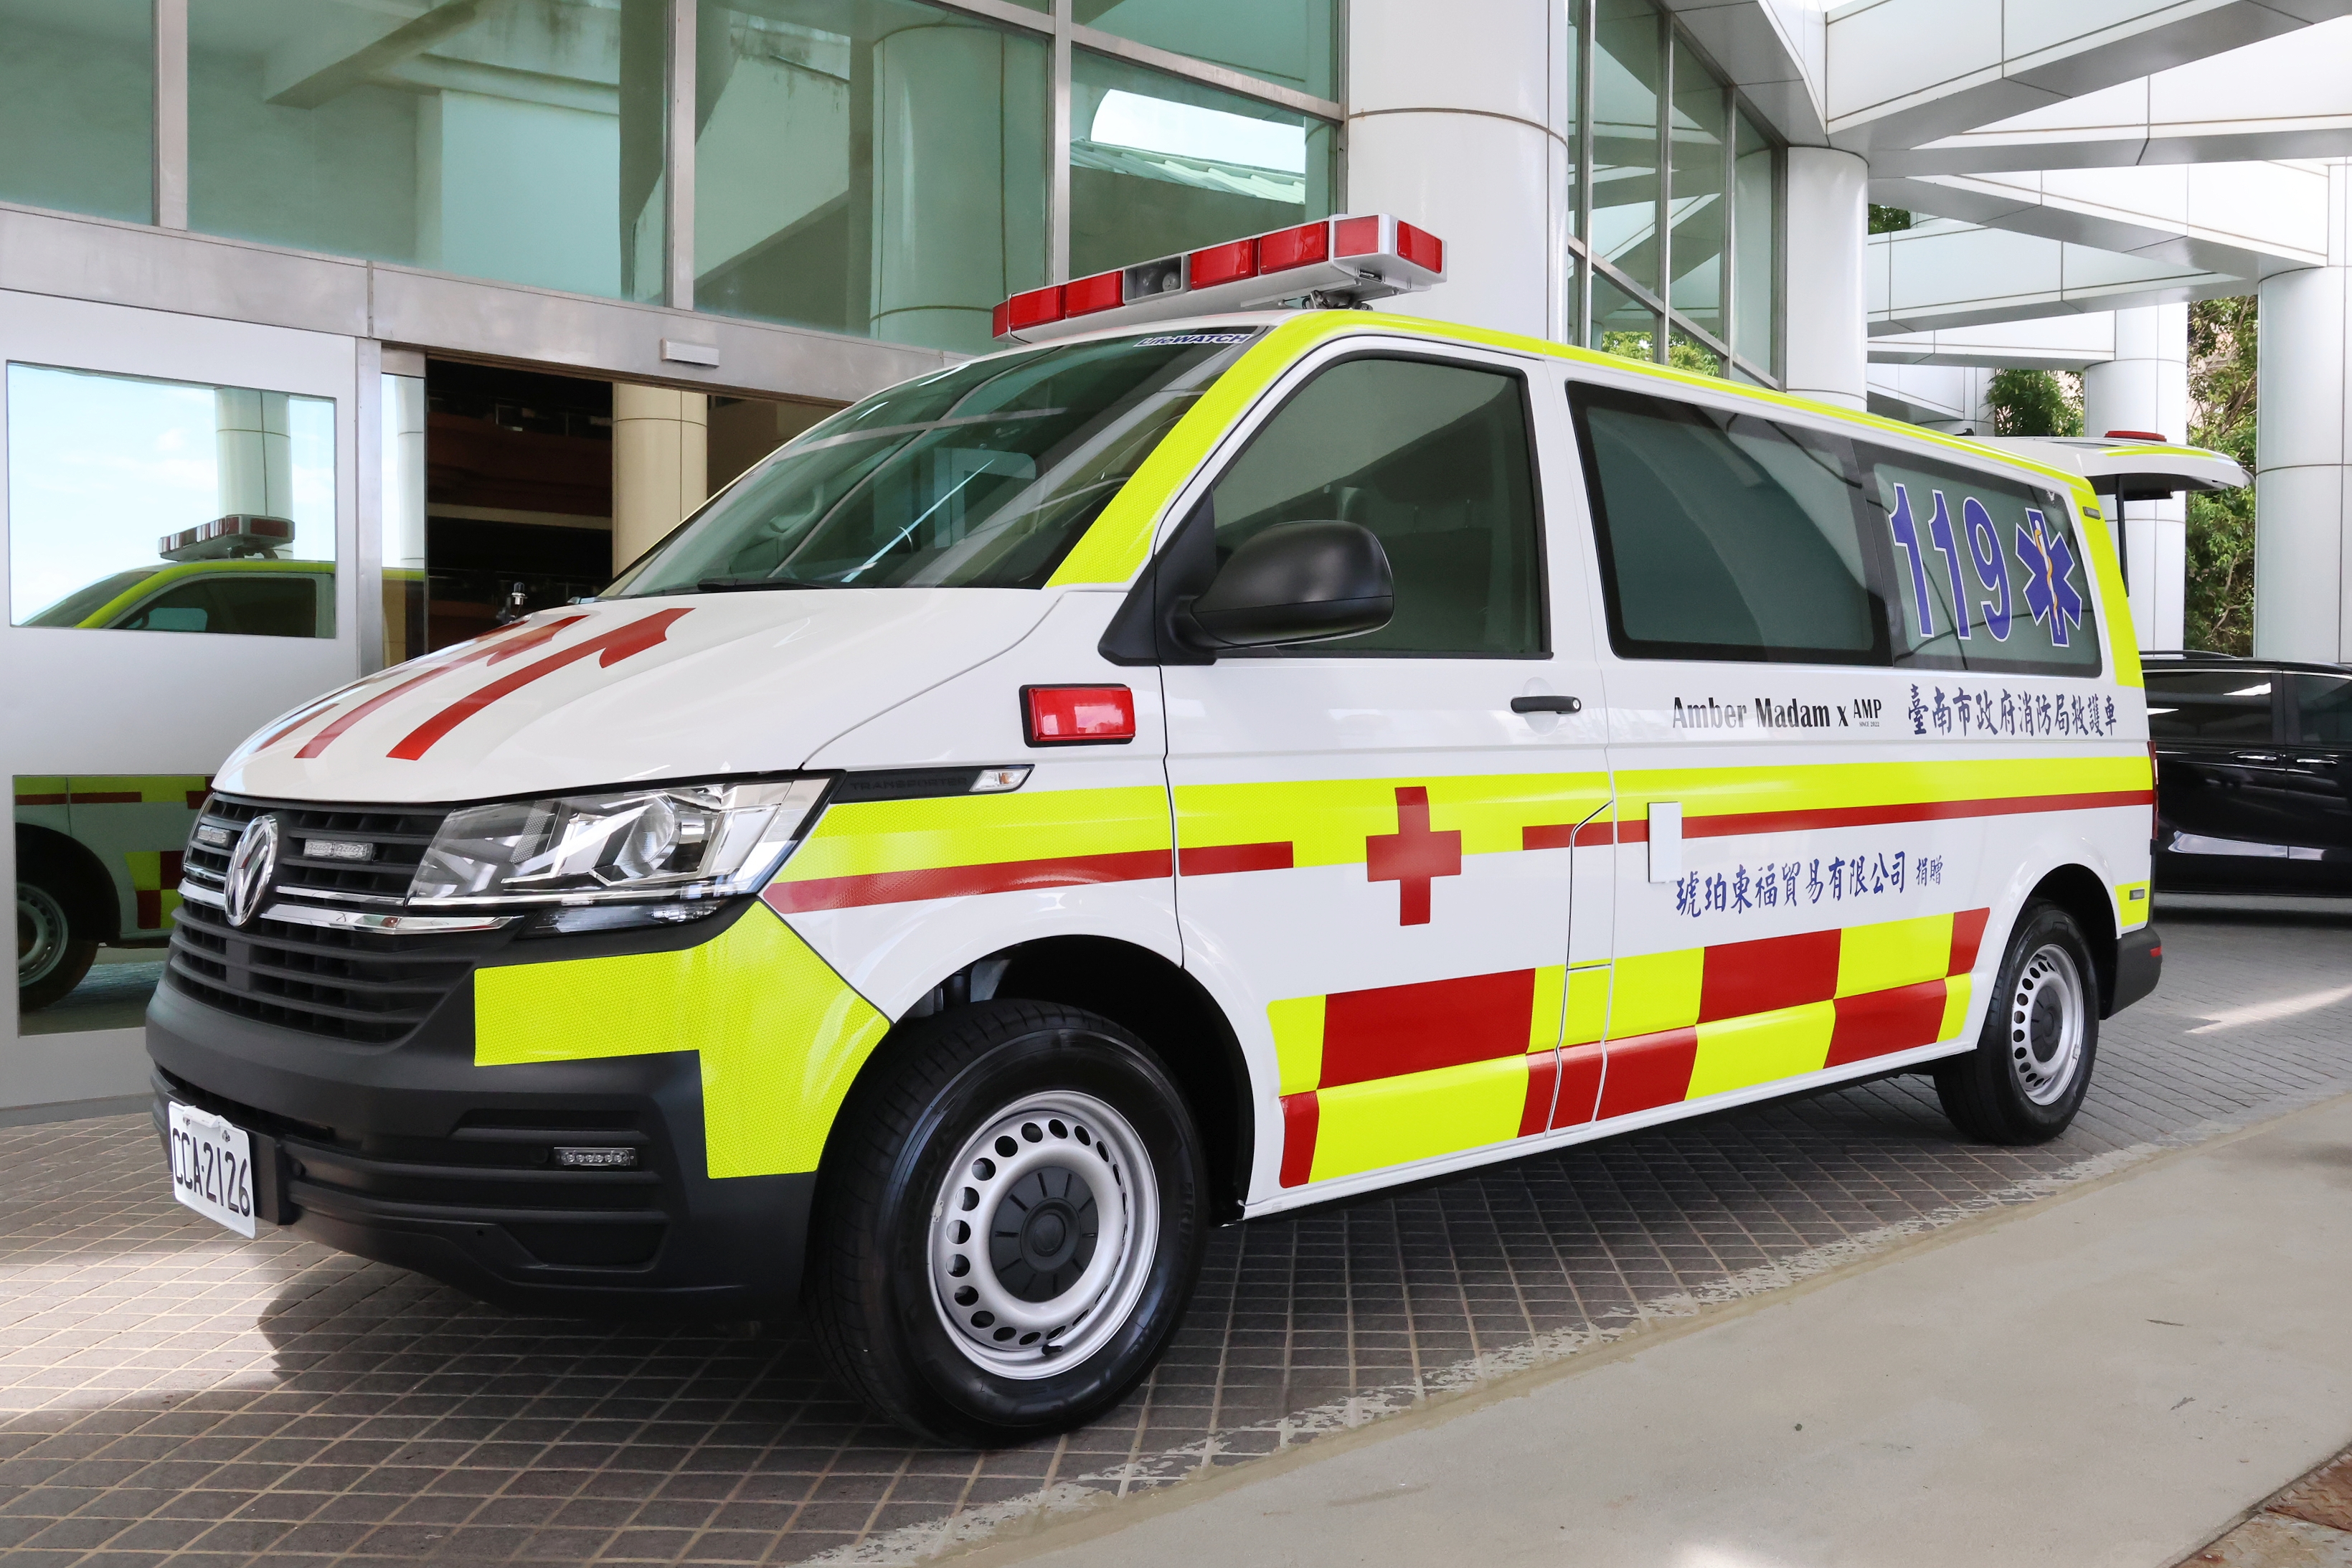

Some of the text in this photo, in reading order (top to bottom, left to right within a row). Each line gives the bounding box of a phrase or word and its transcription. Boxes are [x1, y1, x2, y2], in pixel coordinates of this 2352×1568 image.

[1888, 482, 2012, 643] 119
[1673, 696, 1747, 728] Amber
[1755, 697, 1831, 728] Madam
[1853, 699, 1881, 719] AMP
[1908, 684, 2117, 737] 臺南市政府消防局救護車
[850, 778, 968, 790] TRANSPORTER
[1676, 851, 1944, 918] 琥珀東福貿易有限公司 捐贈
[172, 1127, 251, 1218] CCA-2126
